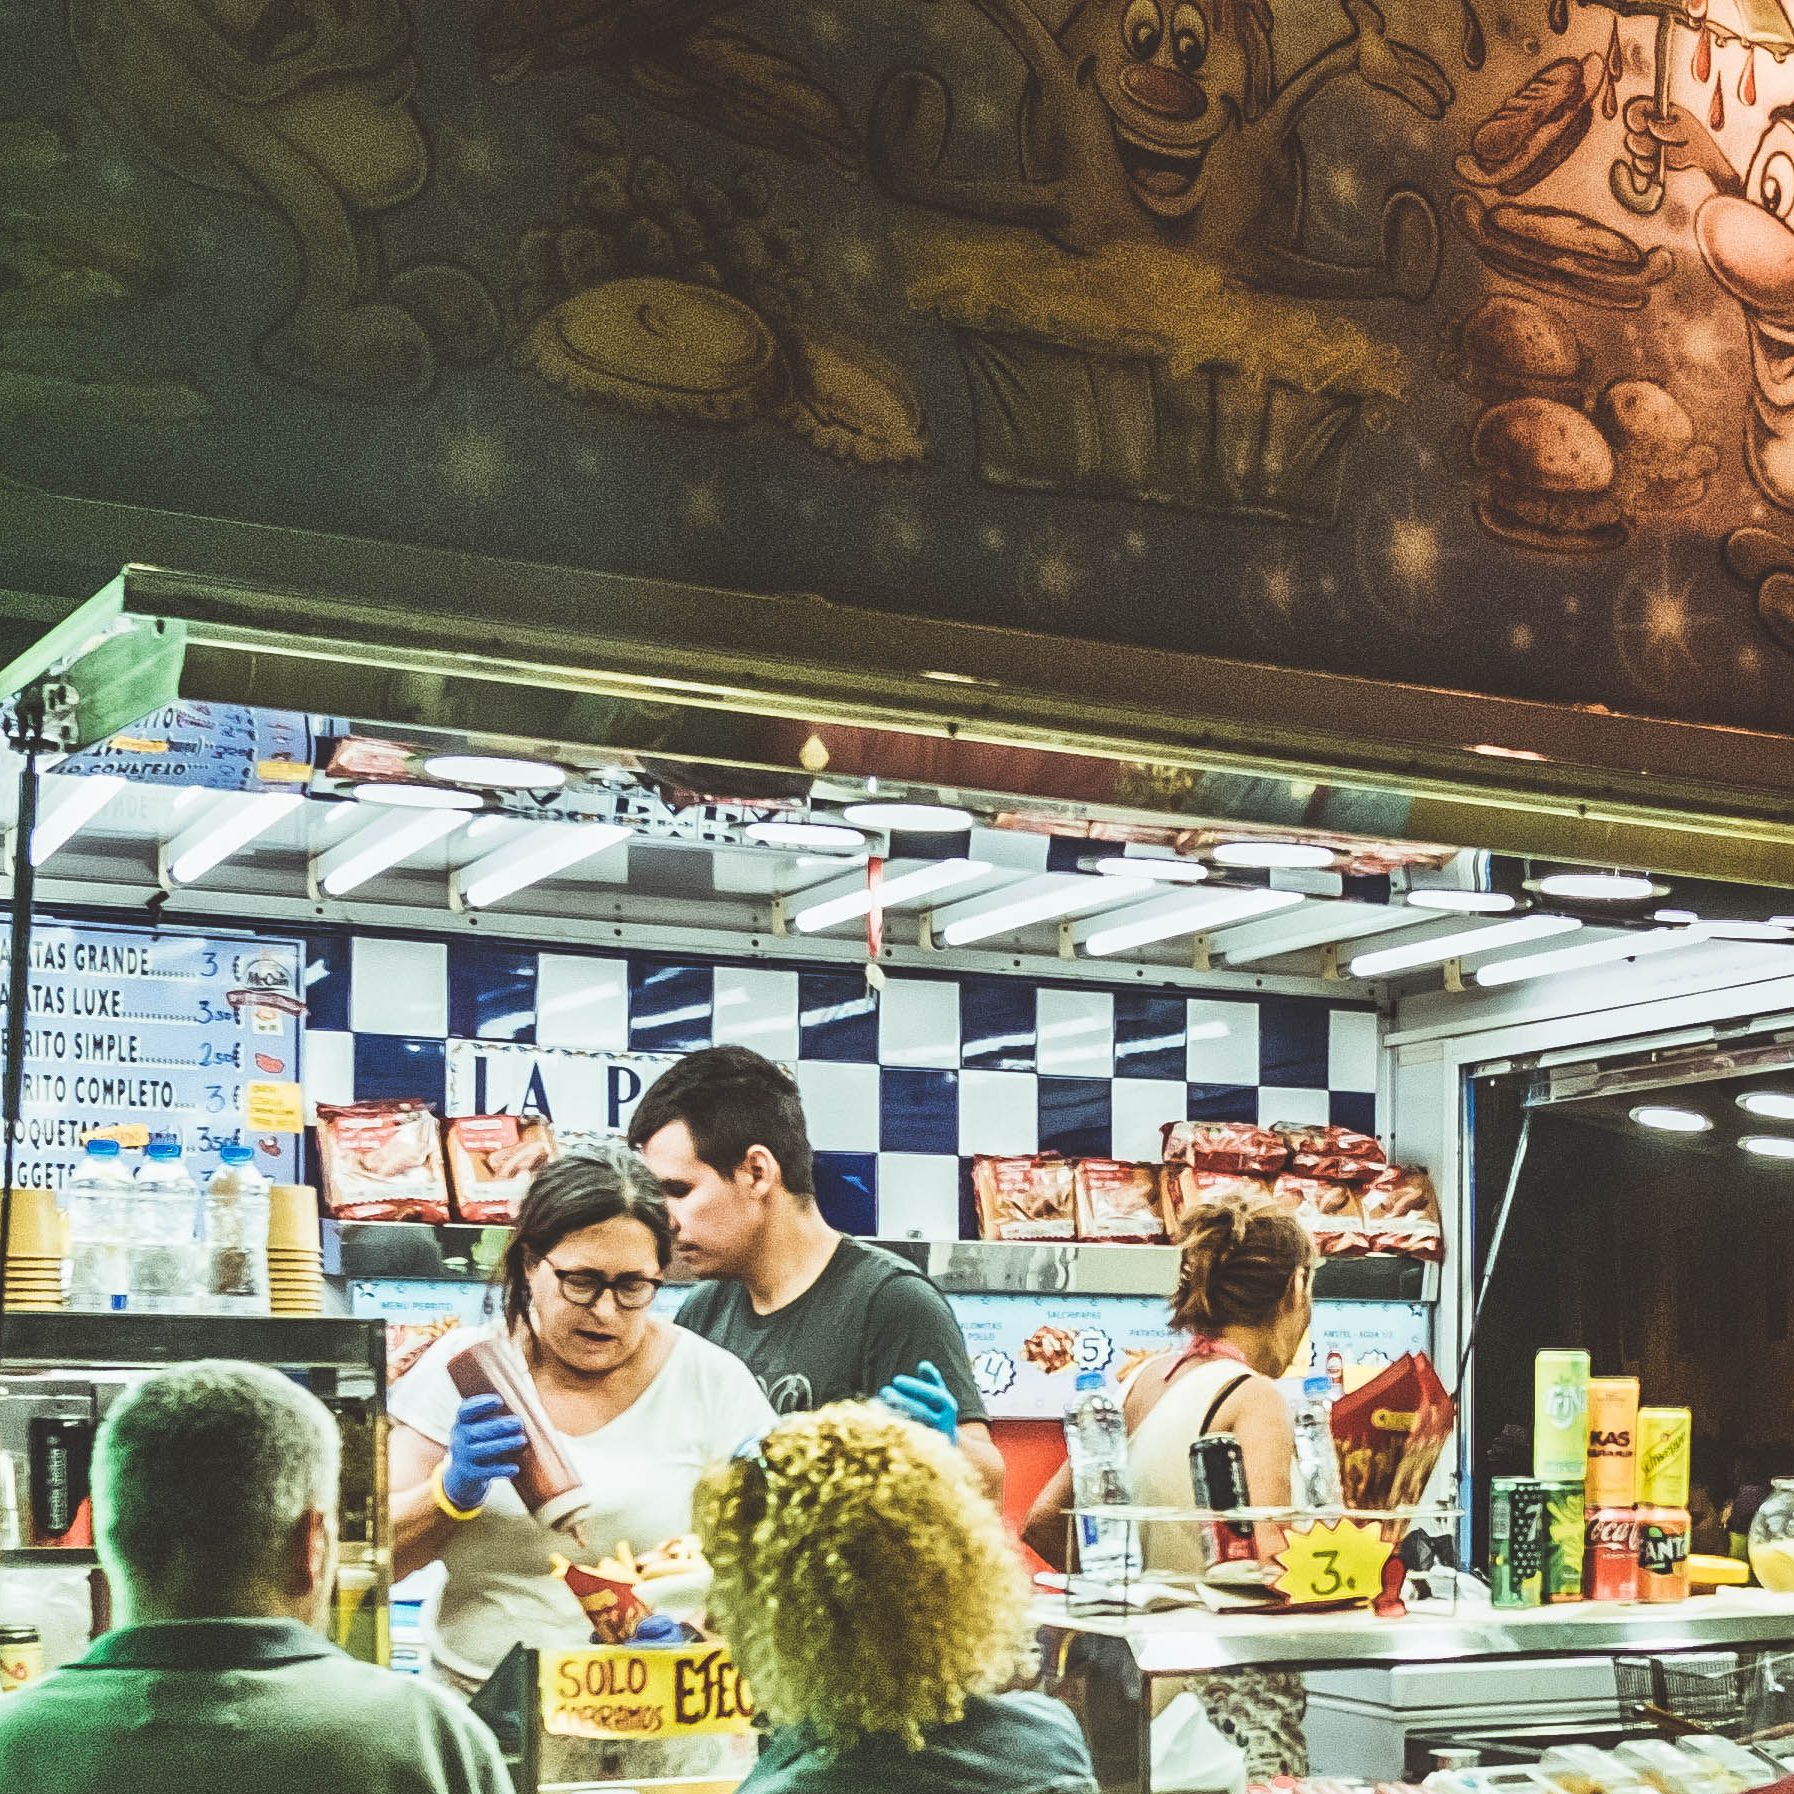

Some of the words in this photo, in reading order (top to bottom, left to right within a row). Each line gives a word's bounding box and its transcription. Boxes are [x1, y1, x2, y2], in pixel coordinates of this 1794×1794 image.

[74, 942, 151, 978] GRANDE
[72, 987, 122, 1018] LUXE
[74, 1031, 139, 1063] SIMPLE
[75, 1076, 174, 1109] COMPLETO
[474, 1055, 554, 1123] LA
[1082, 1337, 1101, 1362] 5
[1590, 1430, 1631, 1448] KAS
[558, 1657, 648, 1699] SOLO
